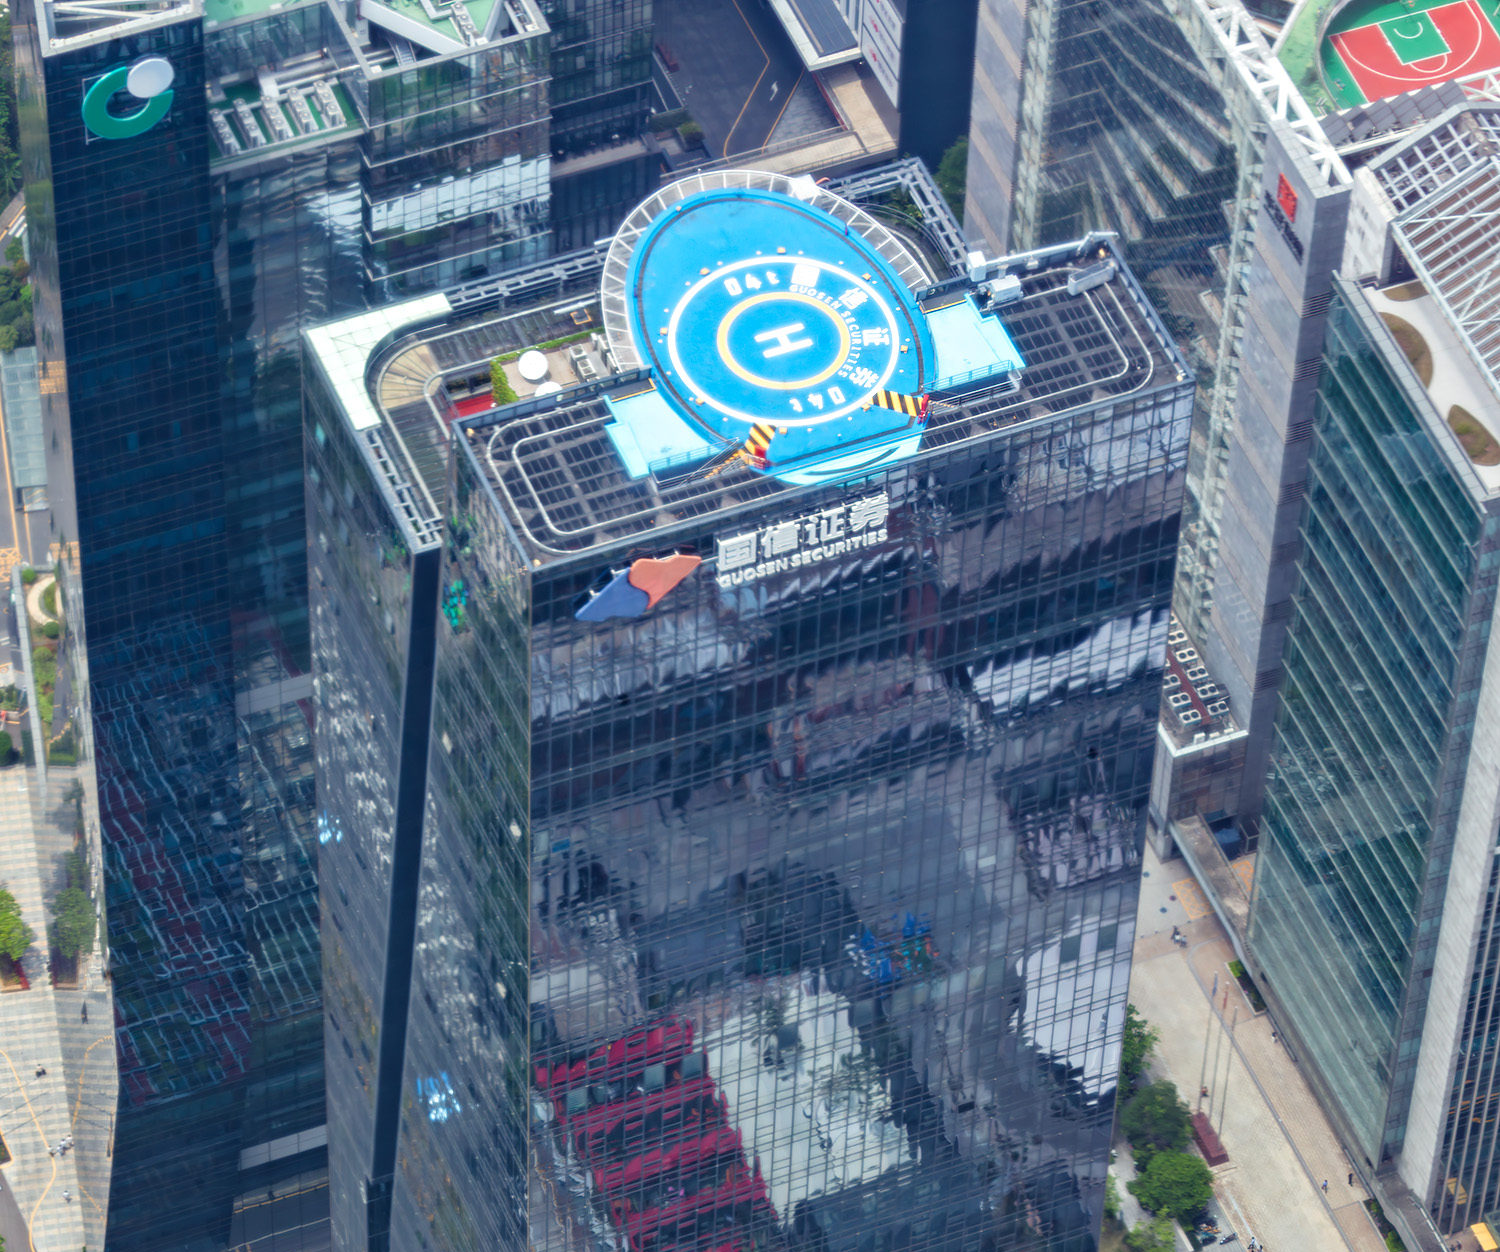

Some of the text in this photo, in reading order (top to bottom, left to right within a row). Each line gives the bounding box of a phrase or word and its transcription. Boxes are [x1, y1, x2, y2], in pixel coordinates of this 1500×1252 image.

[754, 322, 814, 359] H
[789, 285, 862, 378] GUOSEN SECURITIES
[718, 493, 889, 572] 国信证券
[718, 528, 888, 588] GUOSEN SECURITIES
